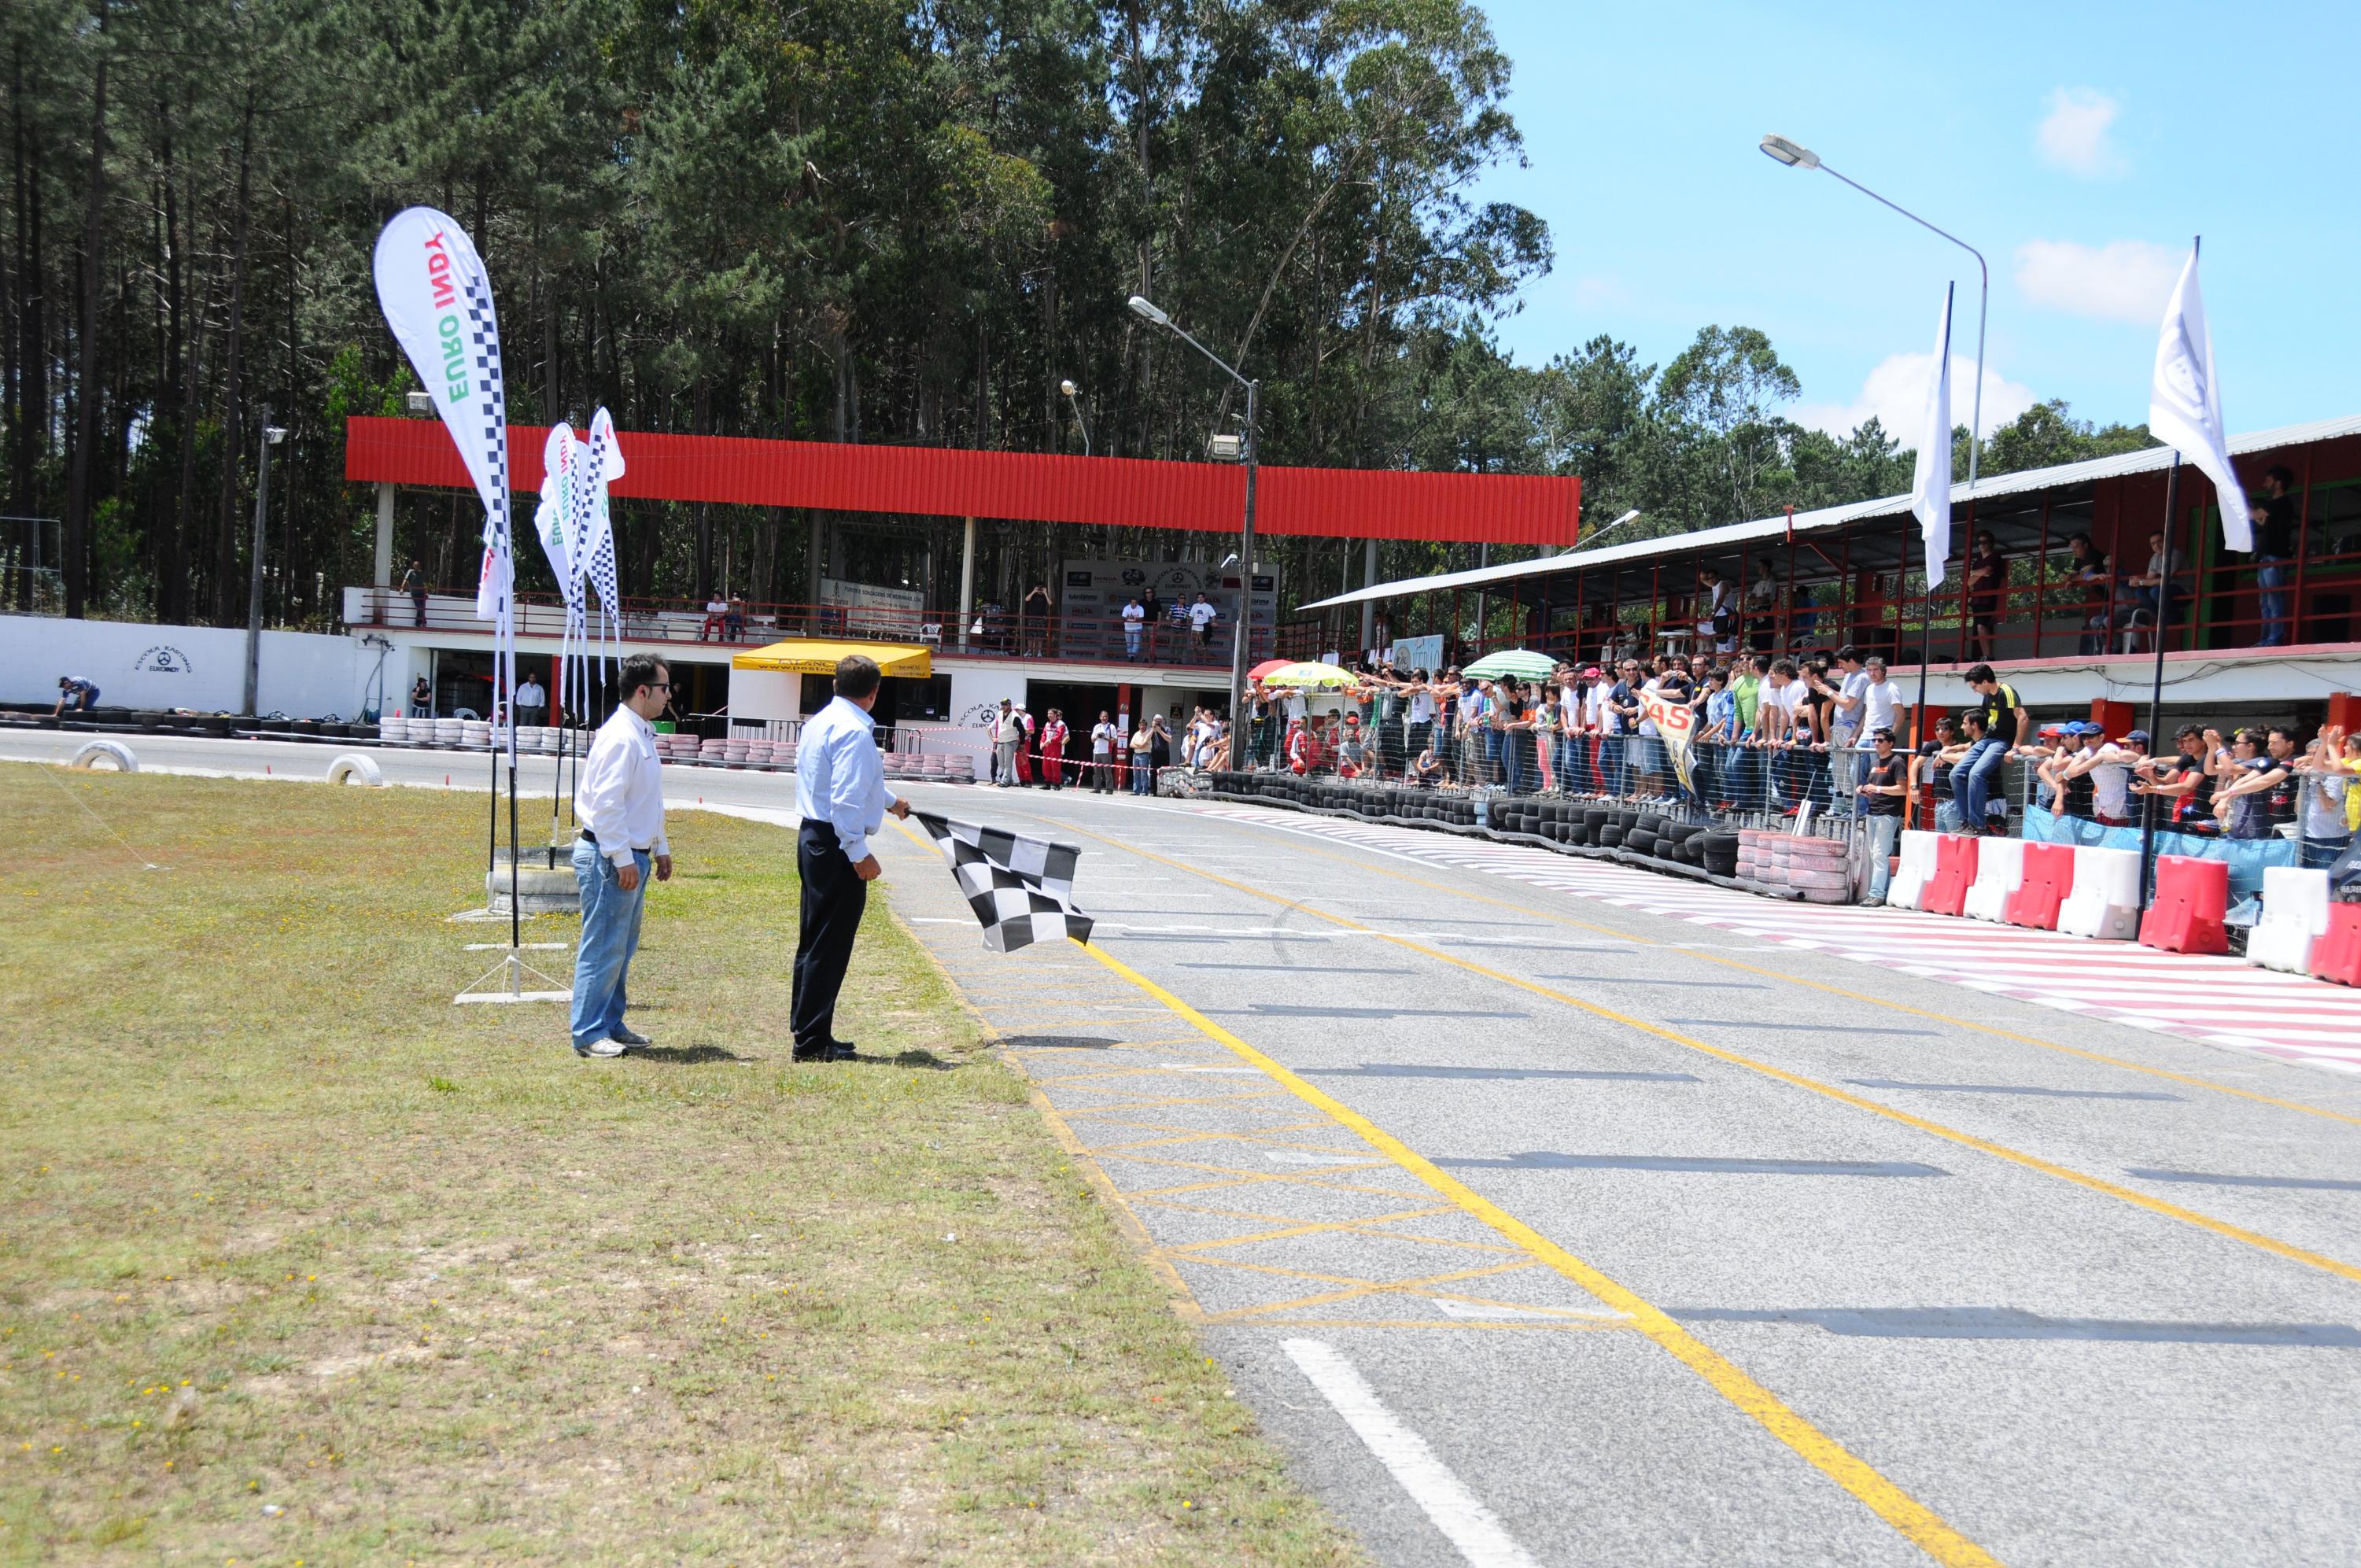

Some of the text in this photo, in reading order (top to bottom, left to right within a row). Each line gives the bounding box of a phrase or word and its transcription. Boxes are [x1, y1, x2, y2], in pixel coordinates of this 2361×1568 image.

[135, 645, 192, 673] ESCOLA KARTING
[957, 703, 983, 728] ESCOLA
